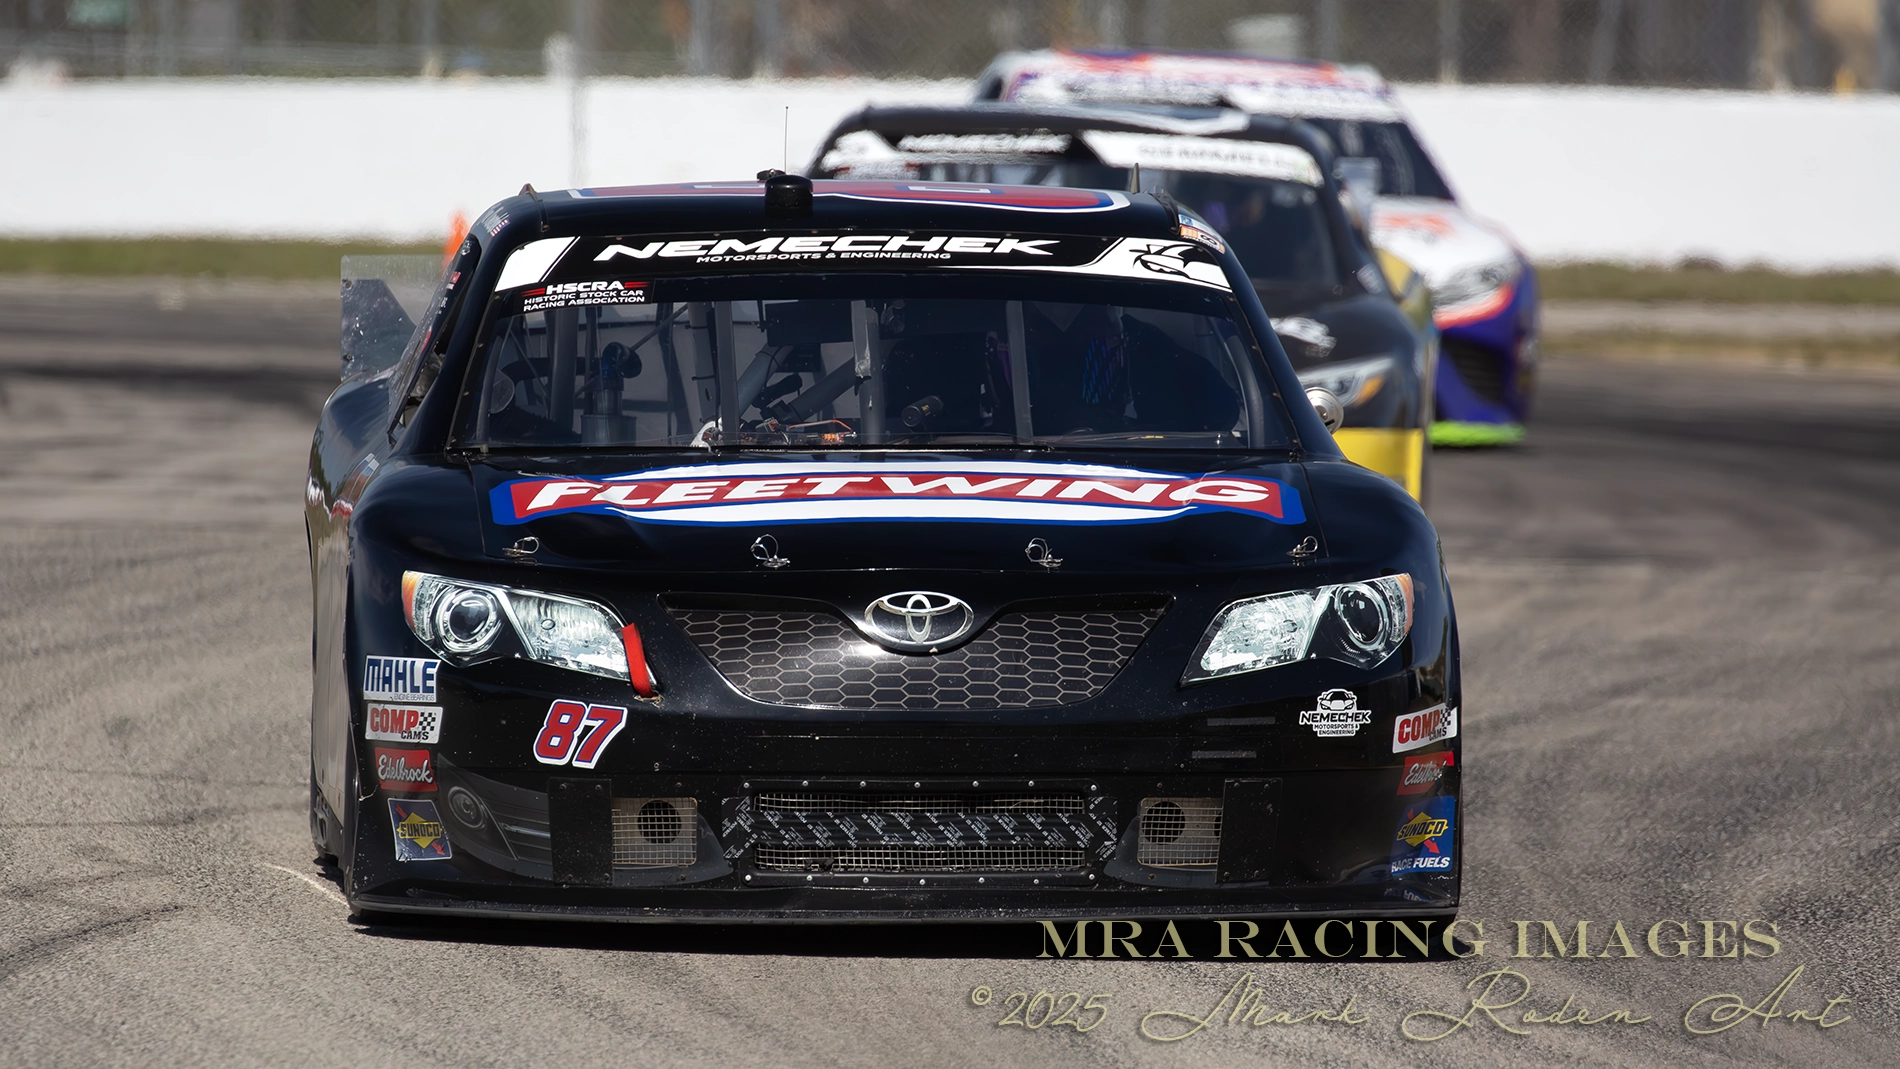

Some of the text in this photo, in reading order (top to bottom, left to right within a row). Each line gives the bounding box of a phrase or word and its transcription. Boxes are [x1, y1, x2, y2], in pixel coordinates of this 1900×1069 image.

[593, 235, 1061, 262] NEMECHEK
[696, 252, 822, 263] MOTORSPORTS
[840, 252, 951, 260] ENGINEERING
[546, 280, 625, 295] HSCRA
[523, 296, 645, 312] RACING ASSOCIATION
[524, 289, 644, 305] HISTORIC STOCK CAR
[526, 475, 1270, 510] FLEETWING
[365, 658, 438, 694] MAHLE
[370, 707, 419, 735] COMP
[1300, 711, 1370, 723] NEMECHEK
[400, 729, 430, 741] CAMS
[533, 699, 628, 769] 87
[1397, 709, 1441, 744] COMP
[1428, 726, 1448, 742] CAMS
[377, 754, 434, 784] Edelbrock
[400, 822, 440, 838] SUNOCO
[1399, 820, 1446, 840] SUNOCO
[1391, 856, 1450, 873] RACE FUELS
